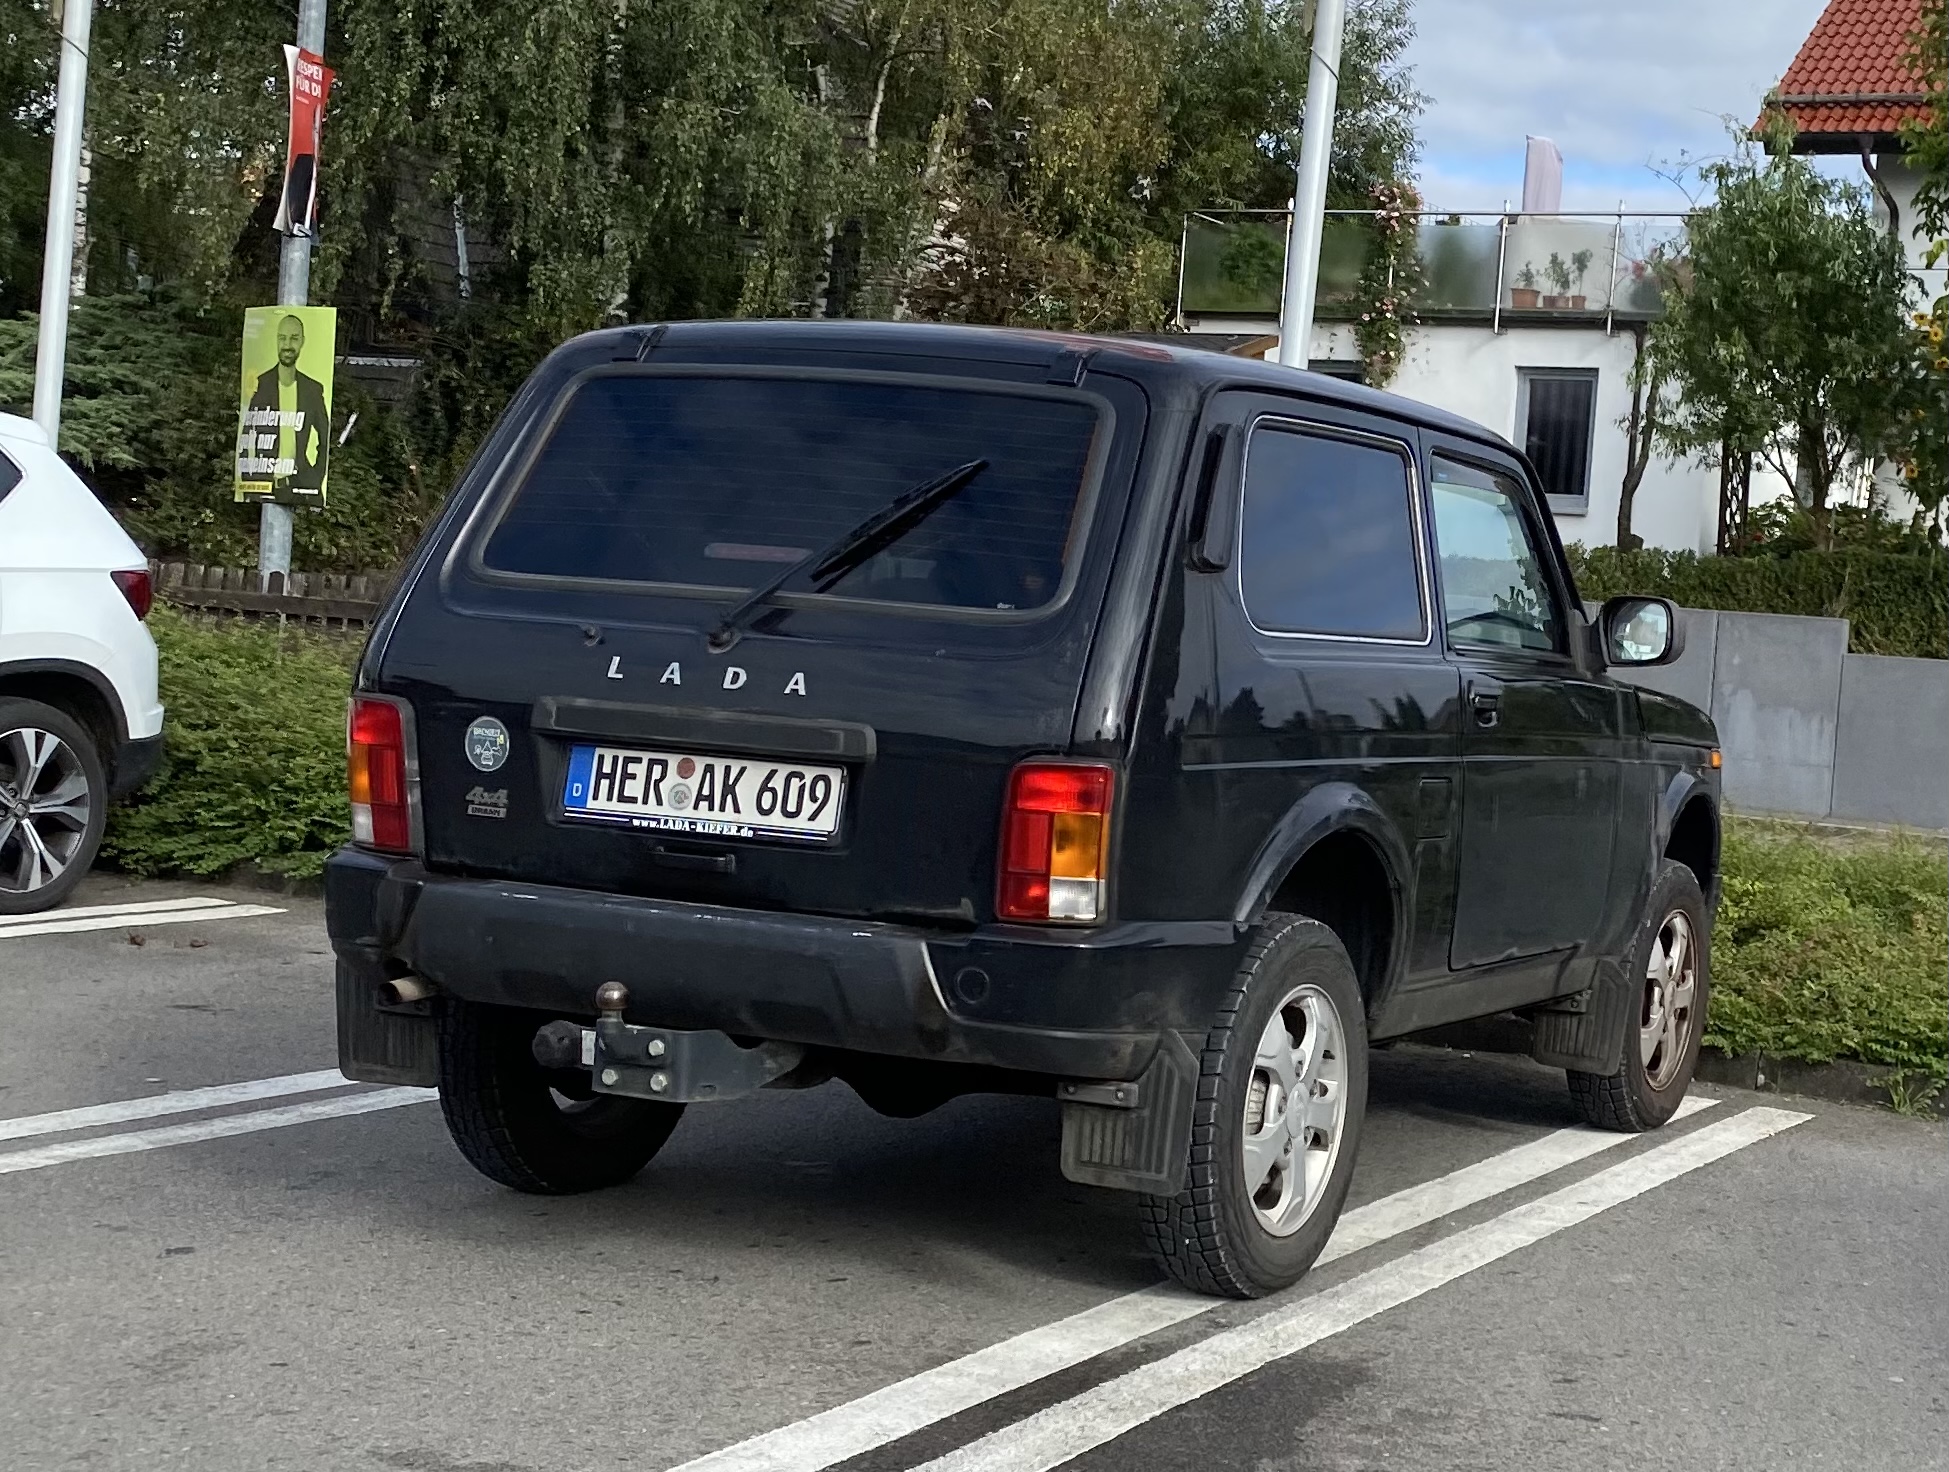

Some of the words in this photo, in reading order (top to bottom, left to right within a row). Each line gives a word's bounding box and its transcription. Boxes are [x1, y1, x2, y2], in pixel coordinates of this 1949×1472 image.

[296, 73, 311, 95] FÜR
[257, 433, 278, 450] nur
[607, 655, 807, 696] LADA
[572, 782, 583, 797] D
[592, 753, 669, 807] HER
[693, 762, 748, 814] AK
[755, 768, 832, 822] 609
[632, 818, 754, 838] www.LADA-KIEFER.de
